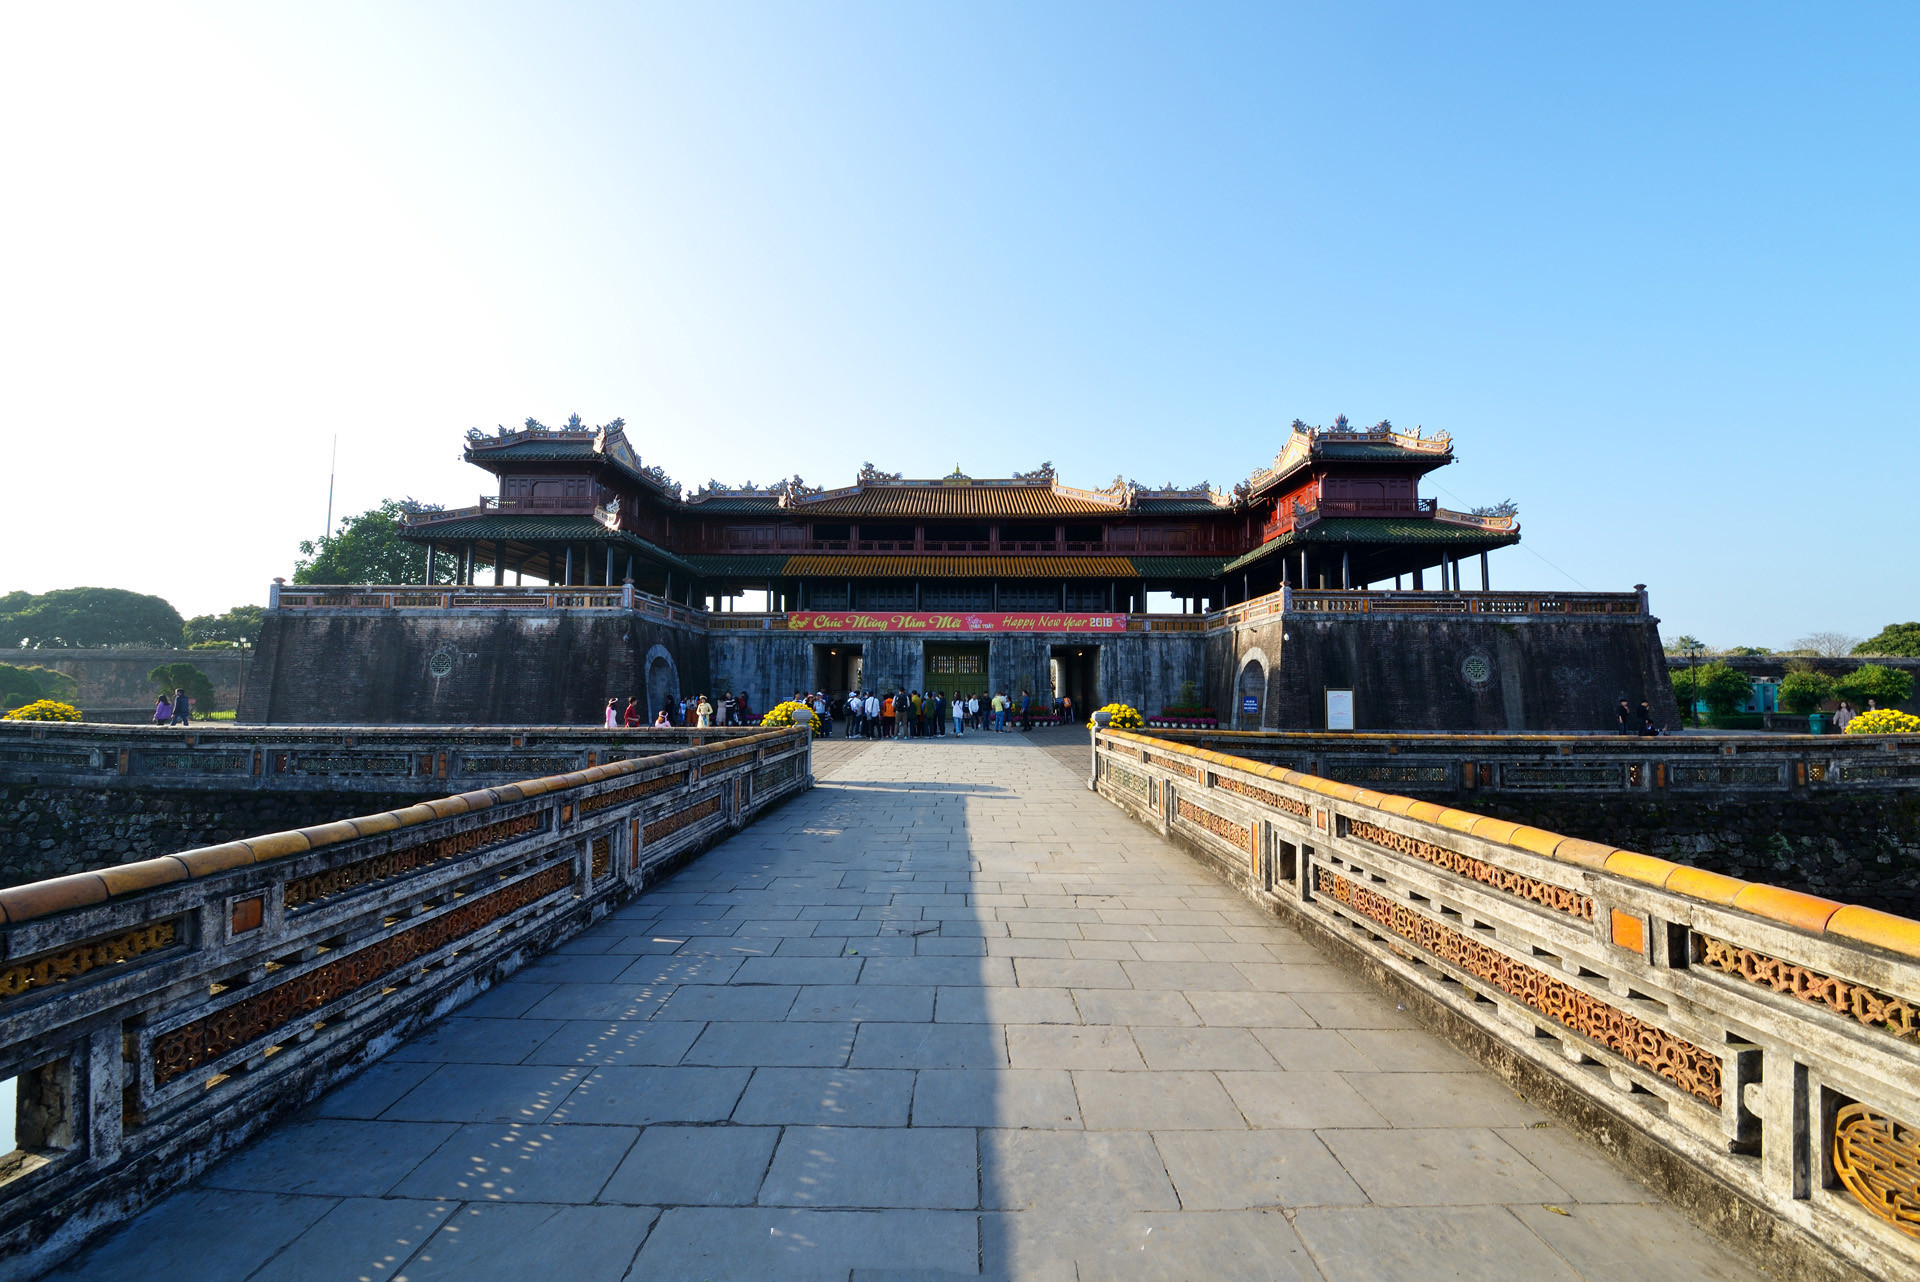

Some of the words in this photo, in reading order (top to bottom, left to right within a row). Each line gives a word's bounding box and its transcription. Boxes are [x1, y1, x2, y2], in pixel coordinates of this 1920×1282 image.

[813, 614, 843, 629] Chúc
[845, 615, 889, 631] Mừng
[890, 615, 927, 629] Năm
[928, 615, 962, 629] Mới
[1002, 616, 1036, 630] Happy
[1038, 616, 1061, 627] New
[1063, 616, 1088, 631] Year
[1089, 617, 1113, 627] 2018
